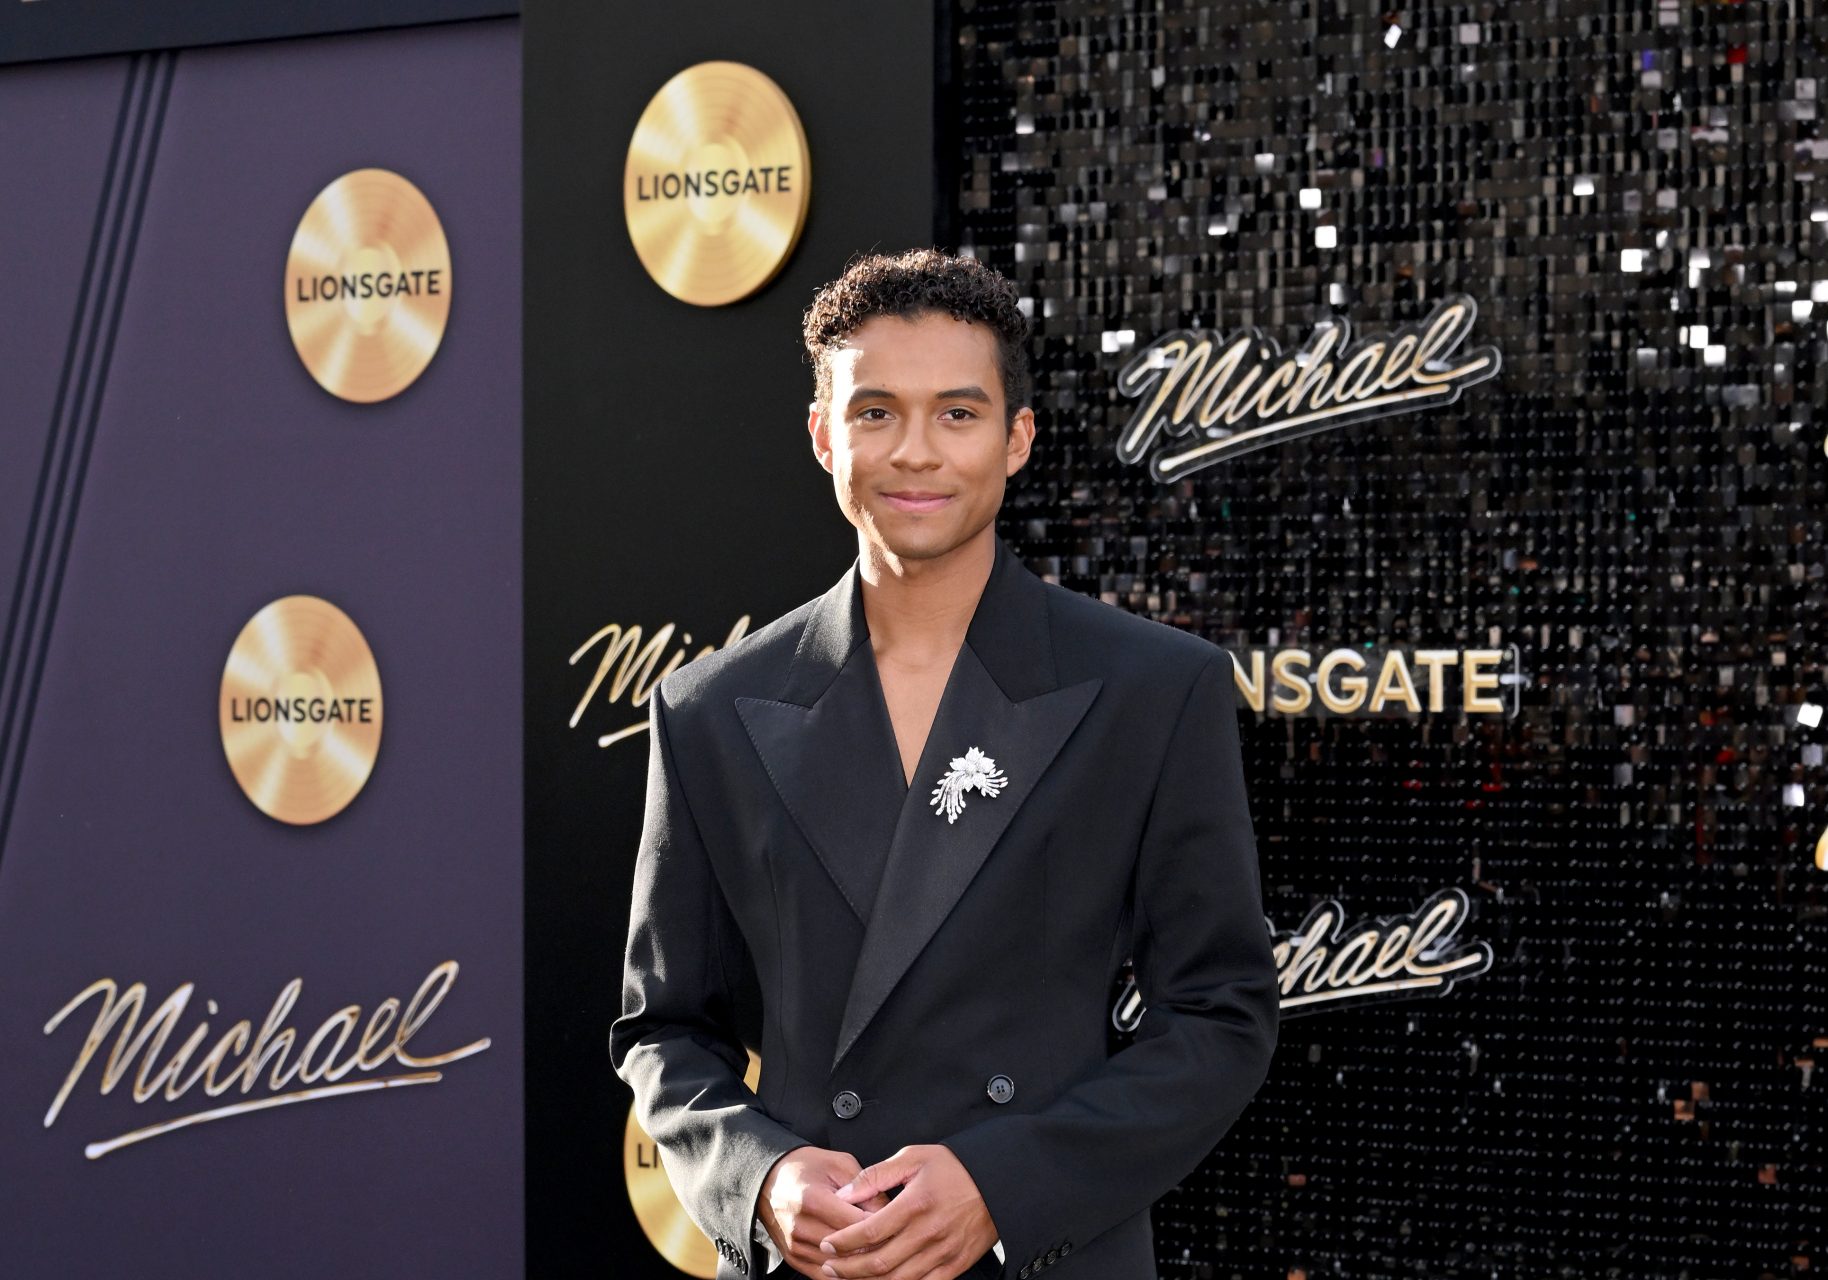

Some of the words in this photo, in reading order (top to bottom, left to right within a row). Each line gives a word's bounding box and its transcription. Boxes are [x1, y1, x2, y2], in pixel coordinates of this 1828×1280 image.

[637, 164, 793, 202] LIONSGATE
[296, 268, 442, 303] LIONSGATE
[1124, 303, 1491, 453] Michael
[231, 697, 374, 724] LIONSGATE
[42, 960, 493, 1129] Michael
